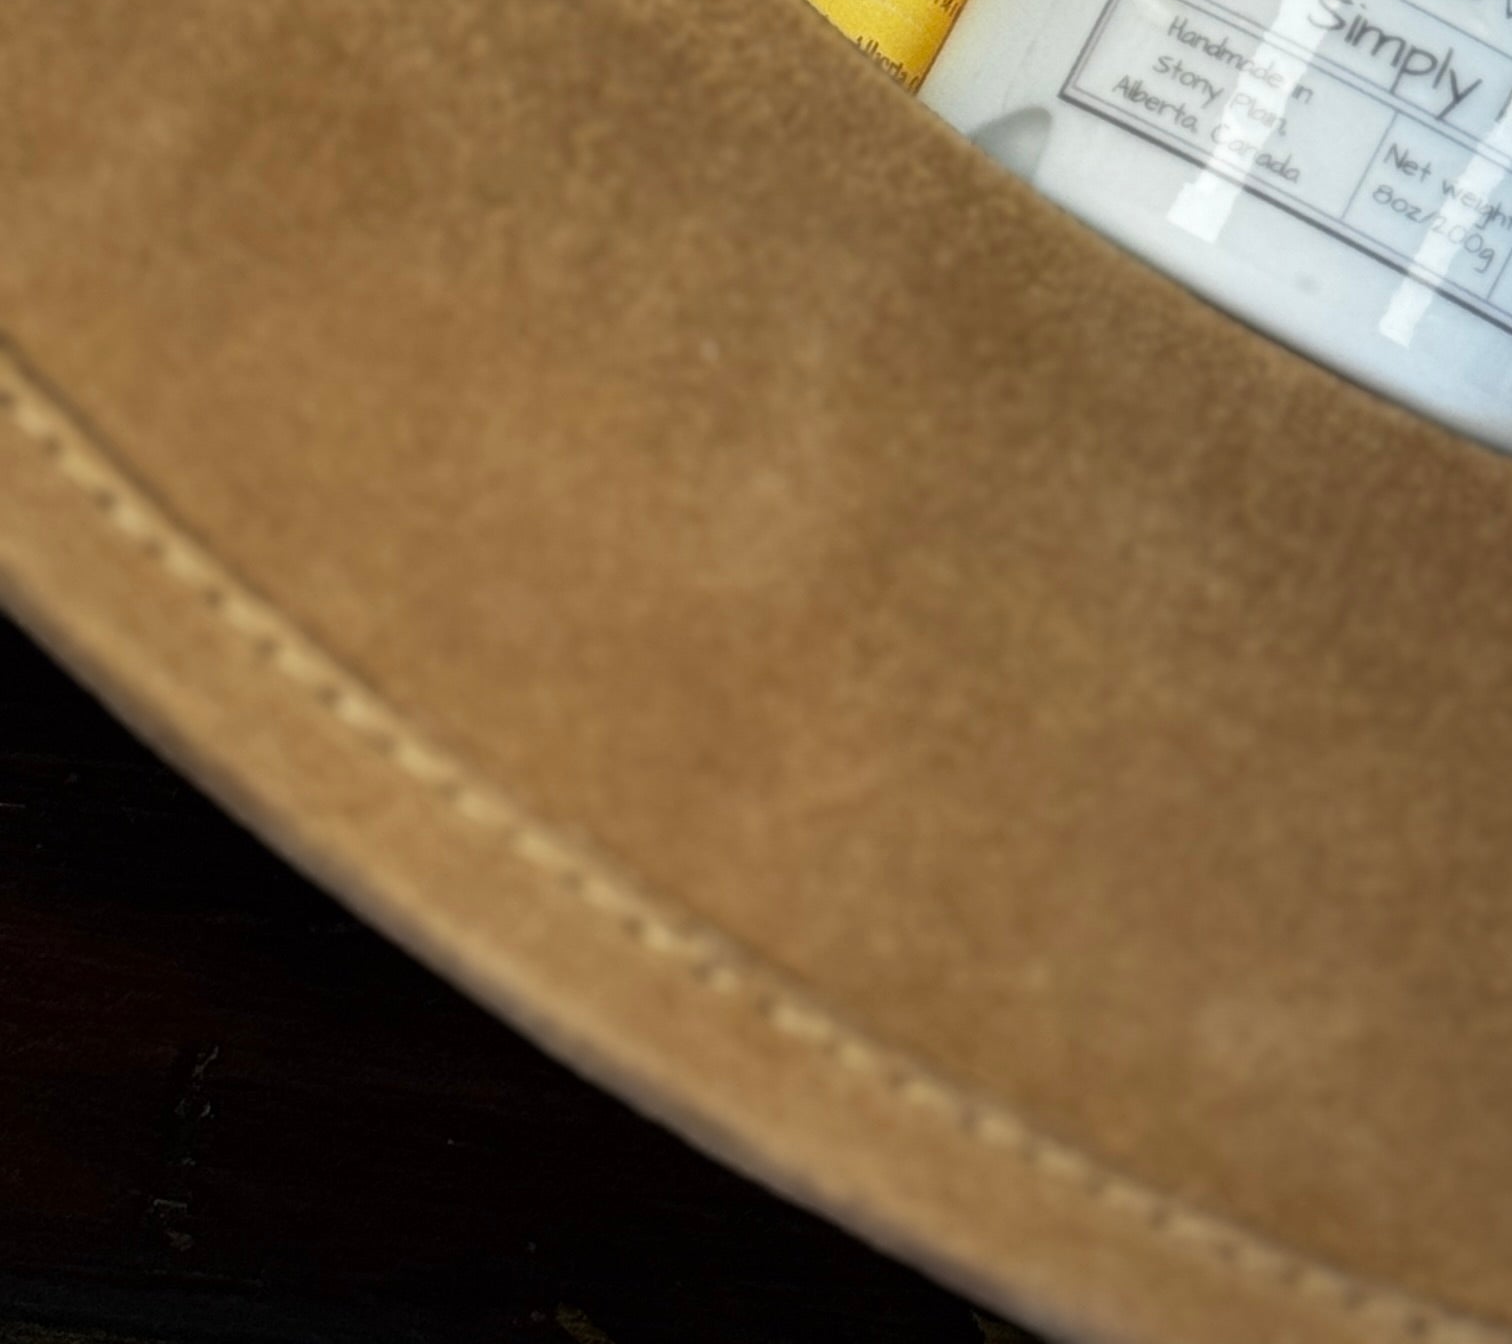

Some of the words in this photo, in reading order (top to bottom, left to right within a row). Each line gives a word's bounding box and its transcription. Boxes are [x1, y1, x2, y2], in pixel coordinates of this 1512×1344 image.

[1166, 14, 1285, 89] Handmade
[1151, 54, 1225, 109] Stony
[1210, 122, 1301, 185] Canada
[1383, 142, 1433, 184] Net
